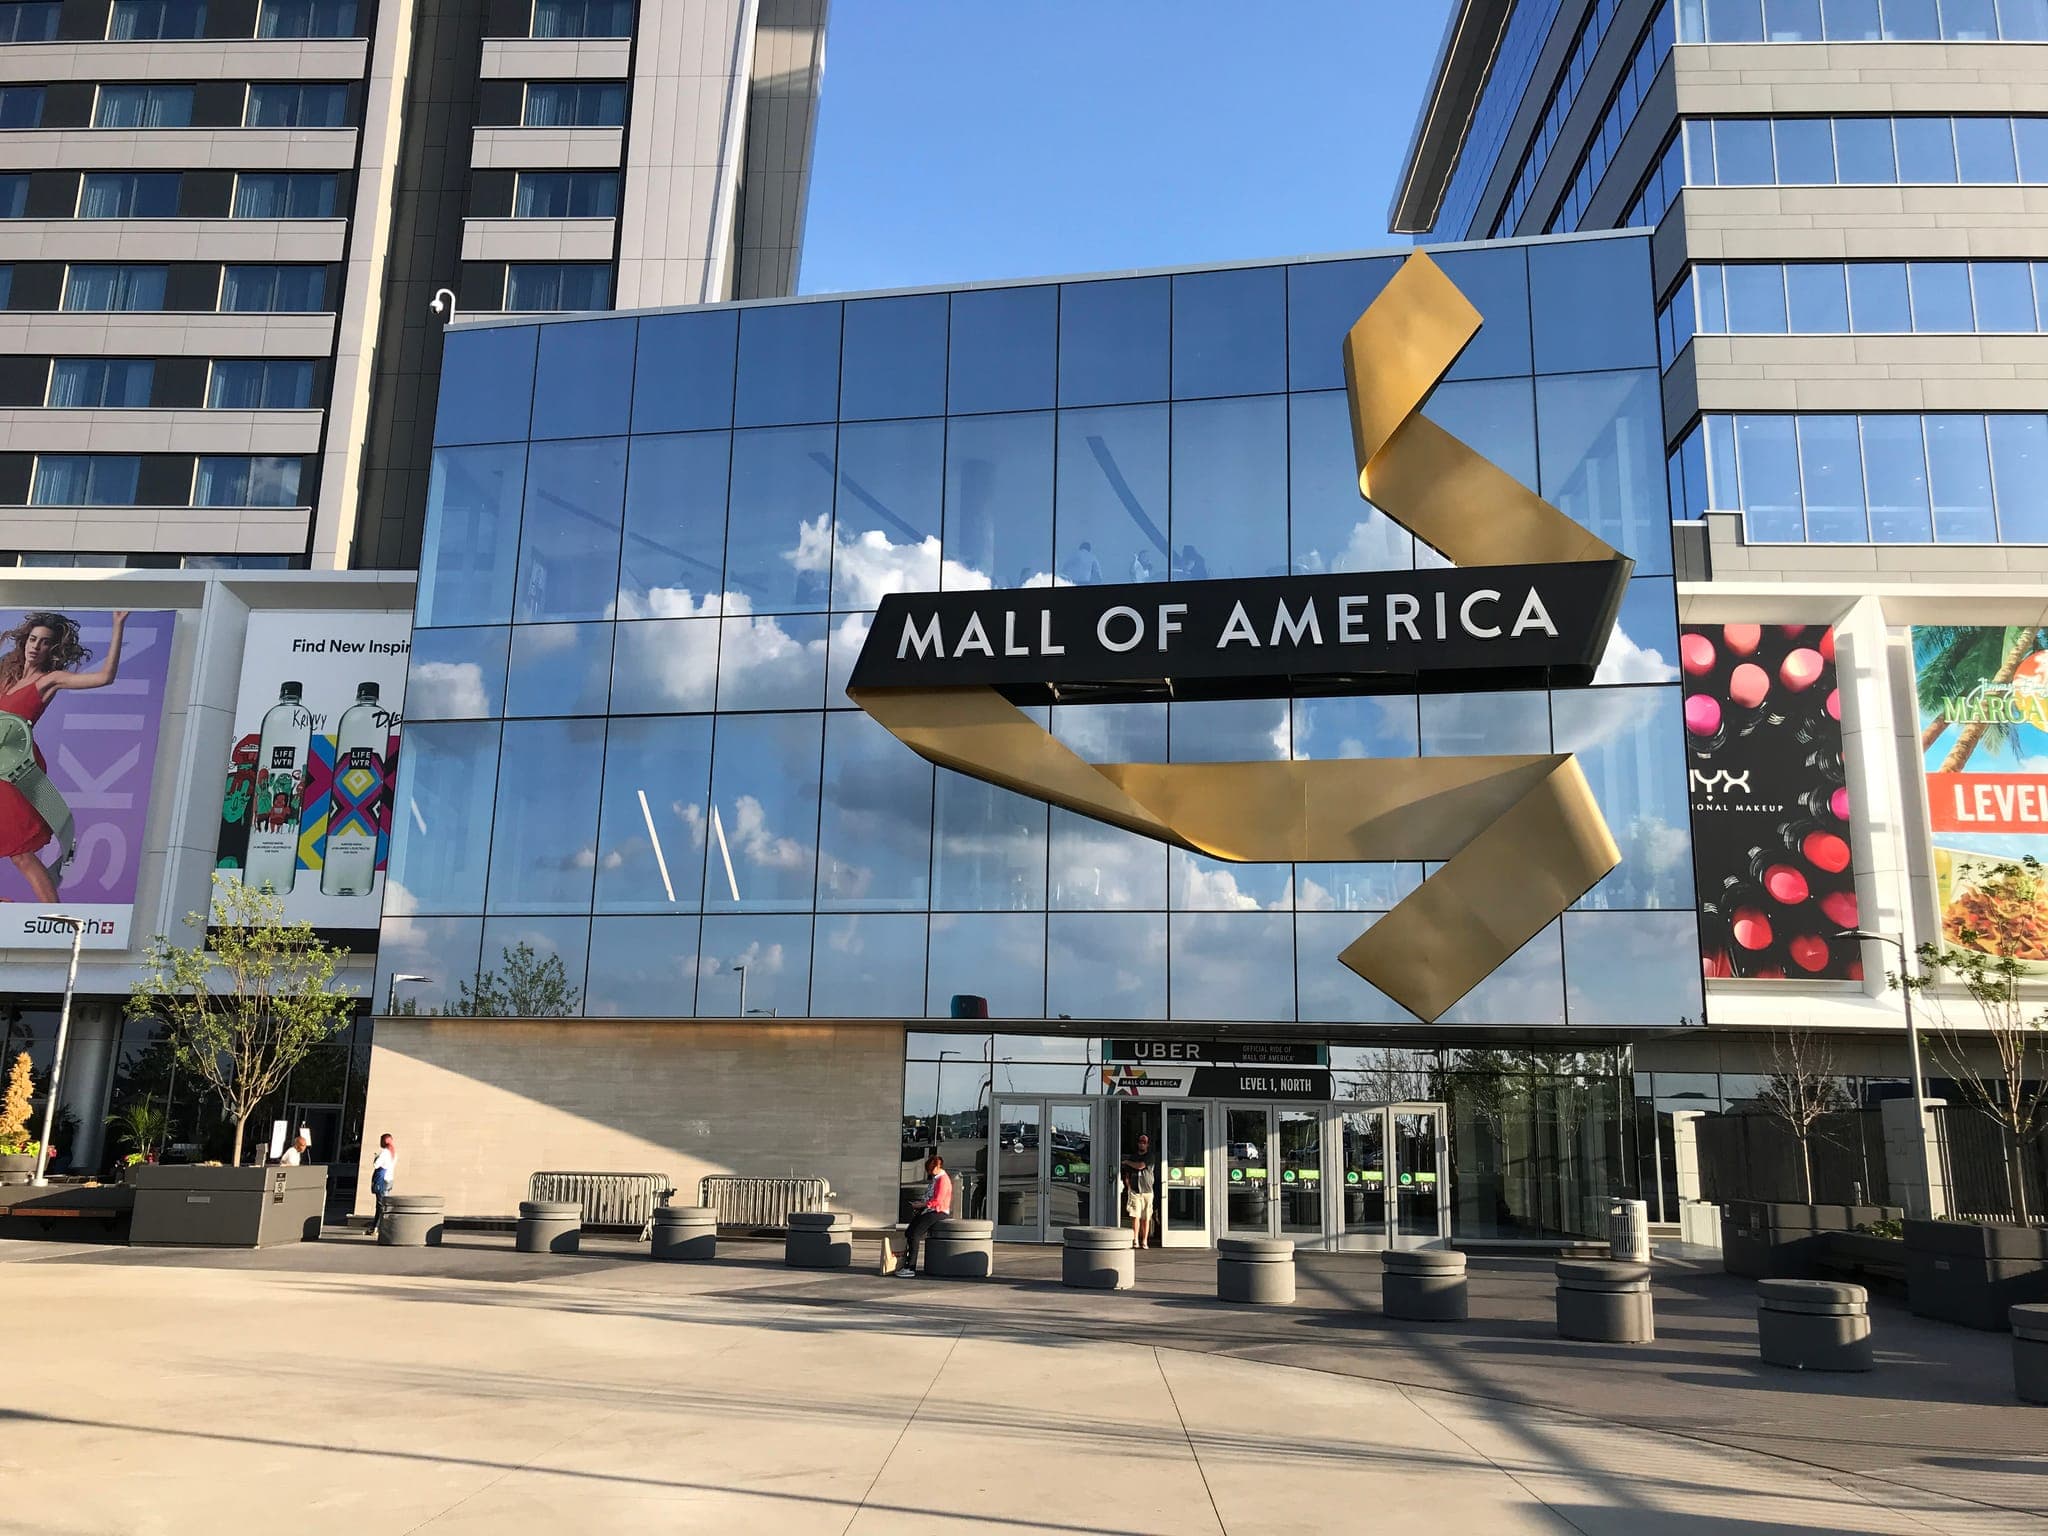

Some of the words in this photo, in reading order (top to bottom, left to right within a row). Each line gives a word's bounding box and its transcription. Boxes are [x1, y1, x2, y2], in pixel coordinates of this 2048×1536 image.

[896, 609, 1065, 660] MALL
[1097, 603, 1187, 652] OF
[1216, 585, 1560, 648] AMERICA
[292, 639, 325, 652] Find
[329, 639, 365, 653] New
[369, 639, 411, 656] Inspir
[35, 627, 158, 891] SKIN
[273, 758, 293, 766] WTR
[274, 750, 294, 758] LIFE
[350, 759, 370, 767] WTR
[1735, 804, 1784, 812] MAKEUP
[1134, 1042, 1200, 1059] UBER
[1240, 1077, 1268, 1091] LEVEL
[1269, 1078, 1277, 1093] 1,
[1280, 1078, 1312, 1092] NORTH
